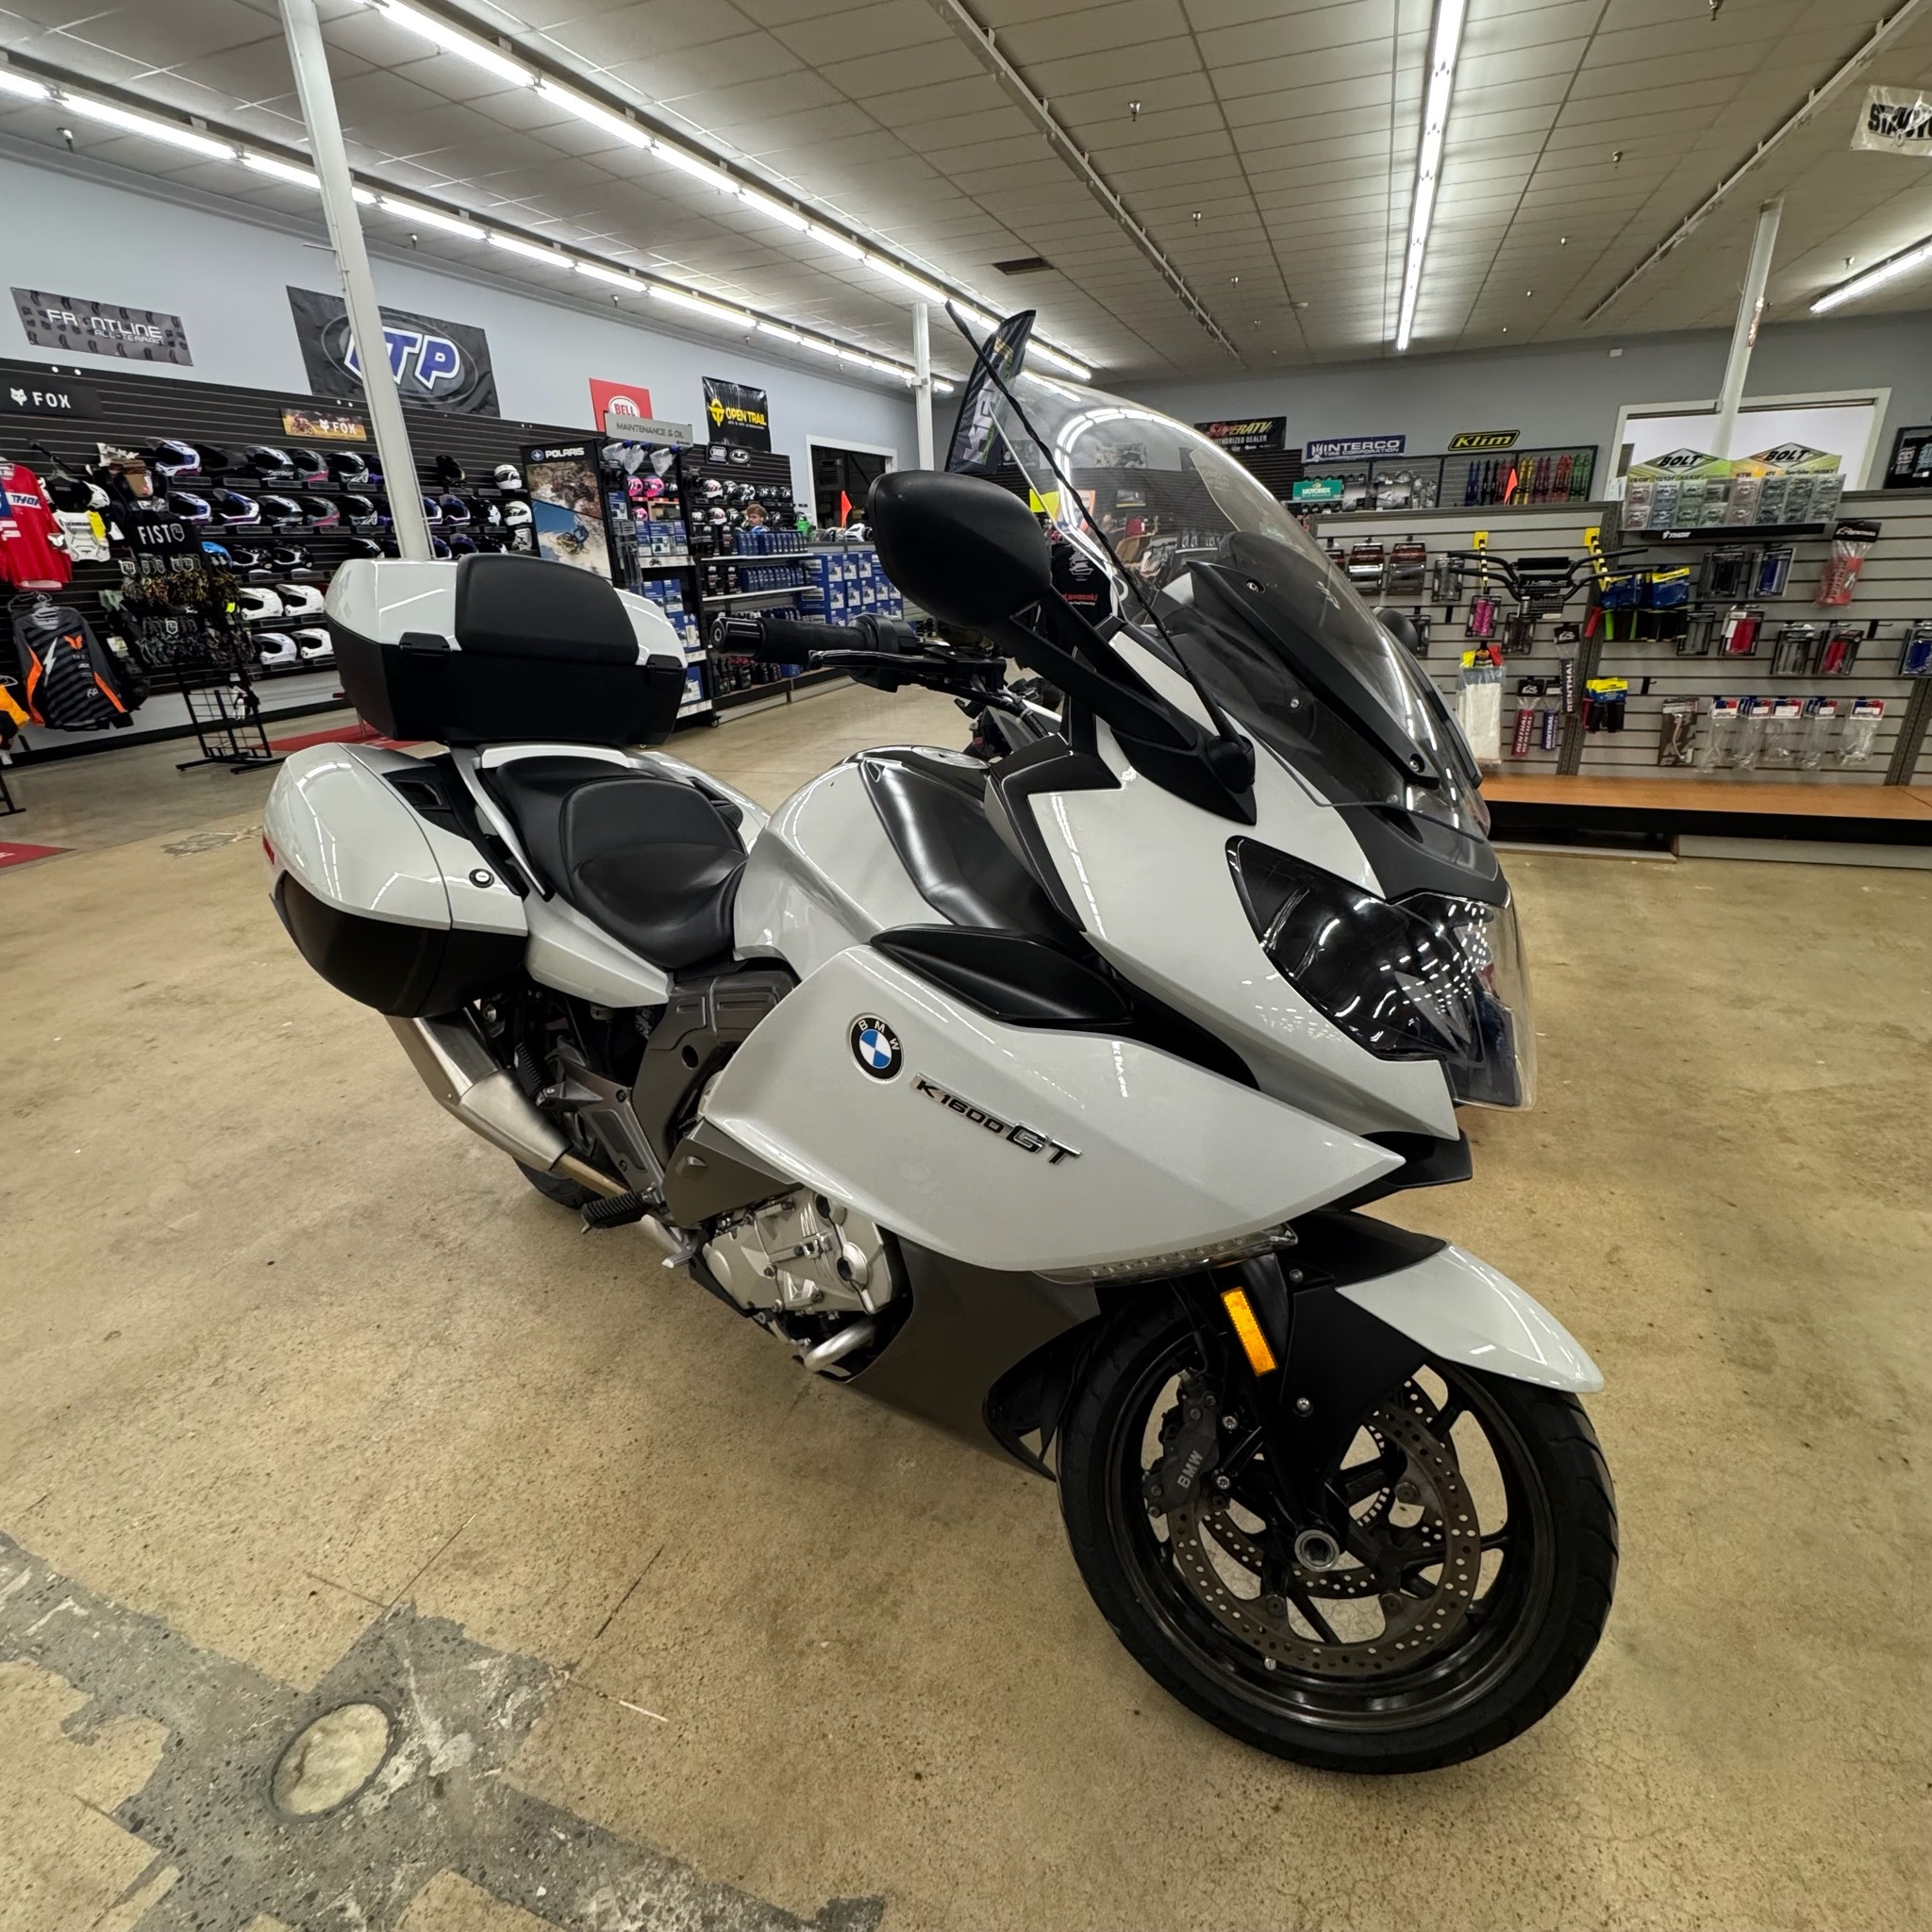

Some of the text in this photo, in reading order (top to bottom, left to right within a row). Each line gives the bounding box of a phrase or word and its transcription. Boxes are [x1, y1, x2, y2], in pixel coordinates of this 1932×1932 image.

[32, 391, 71, 408] FOX
[614, 403, 636, 416] BELL
[725, 407, 747, 422] OPEN
[747, 410, 767, 425] TRAIL
[332, 422, 357, 434] FOX
[616, 422, 666, 437] MAINTENANCE
[674, 430, 685, 439] OIL
[545, 447, 585, 458] POLARIS
[1324, 440, 1400, 453] INTERCO
[1657, 455, 1702, 467] BOLT
[1763, 450, 1810, 461] BOLT
[137, 525, 172, 544] FIST
[858, 1020, 900, 1051] BMW
[1177, 1450, 1203, 1489] BMW
